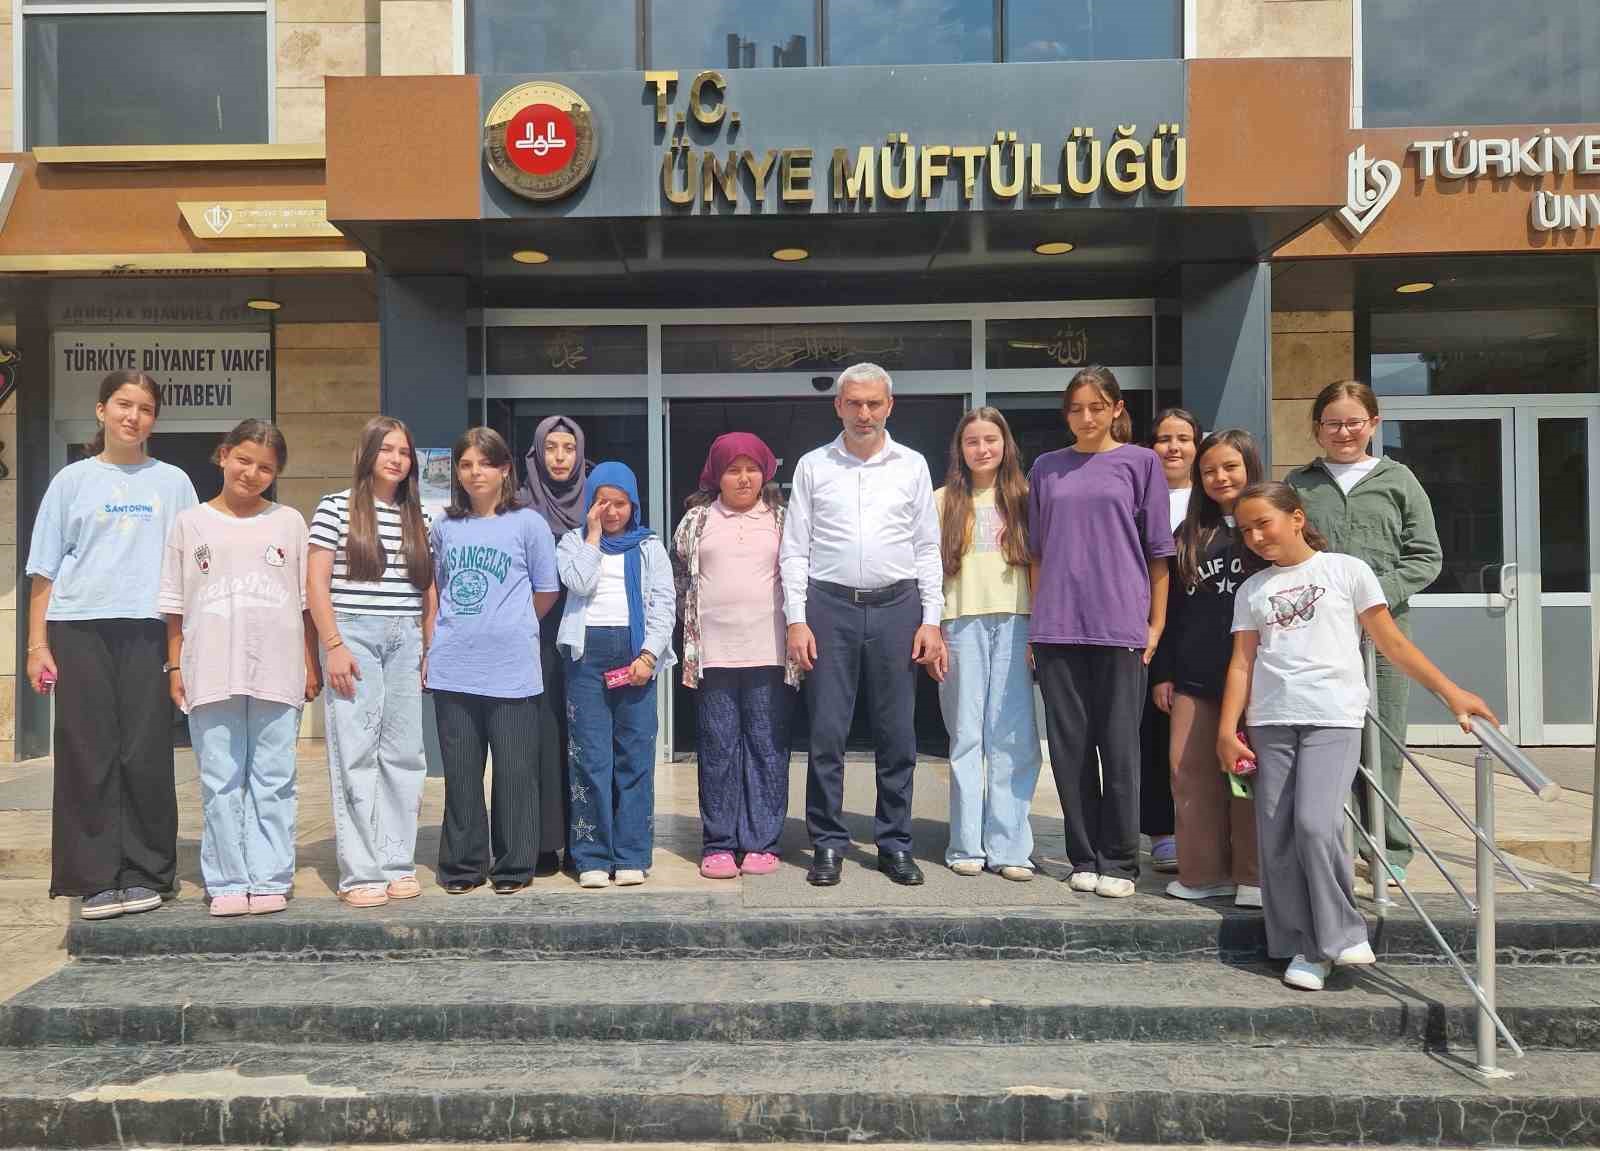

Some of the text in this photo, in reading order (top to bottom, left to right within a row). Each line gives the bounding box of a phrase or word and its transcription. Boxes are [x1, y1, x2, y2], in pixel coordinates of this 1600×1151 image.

[644, 71, 741, 127] T.C.
[662, 137, 816, 204] ÜNYE
[832, 122, 1187, 200] MÜFTÜLÜĞÜ
[1410, 128, 1600, 178] TÜRKİYE
[64, 343, 136, 371] TÜRKİYE
[143, 343, 215, 372] DİYANET
[158, 378, 232, 407] KİTABEVİ
[458, 545, 513, 585] ANGELES
